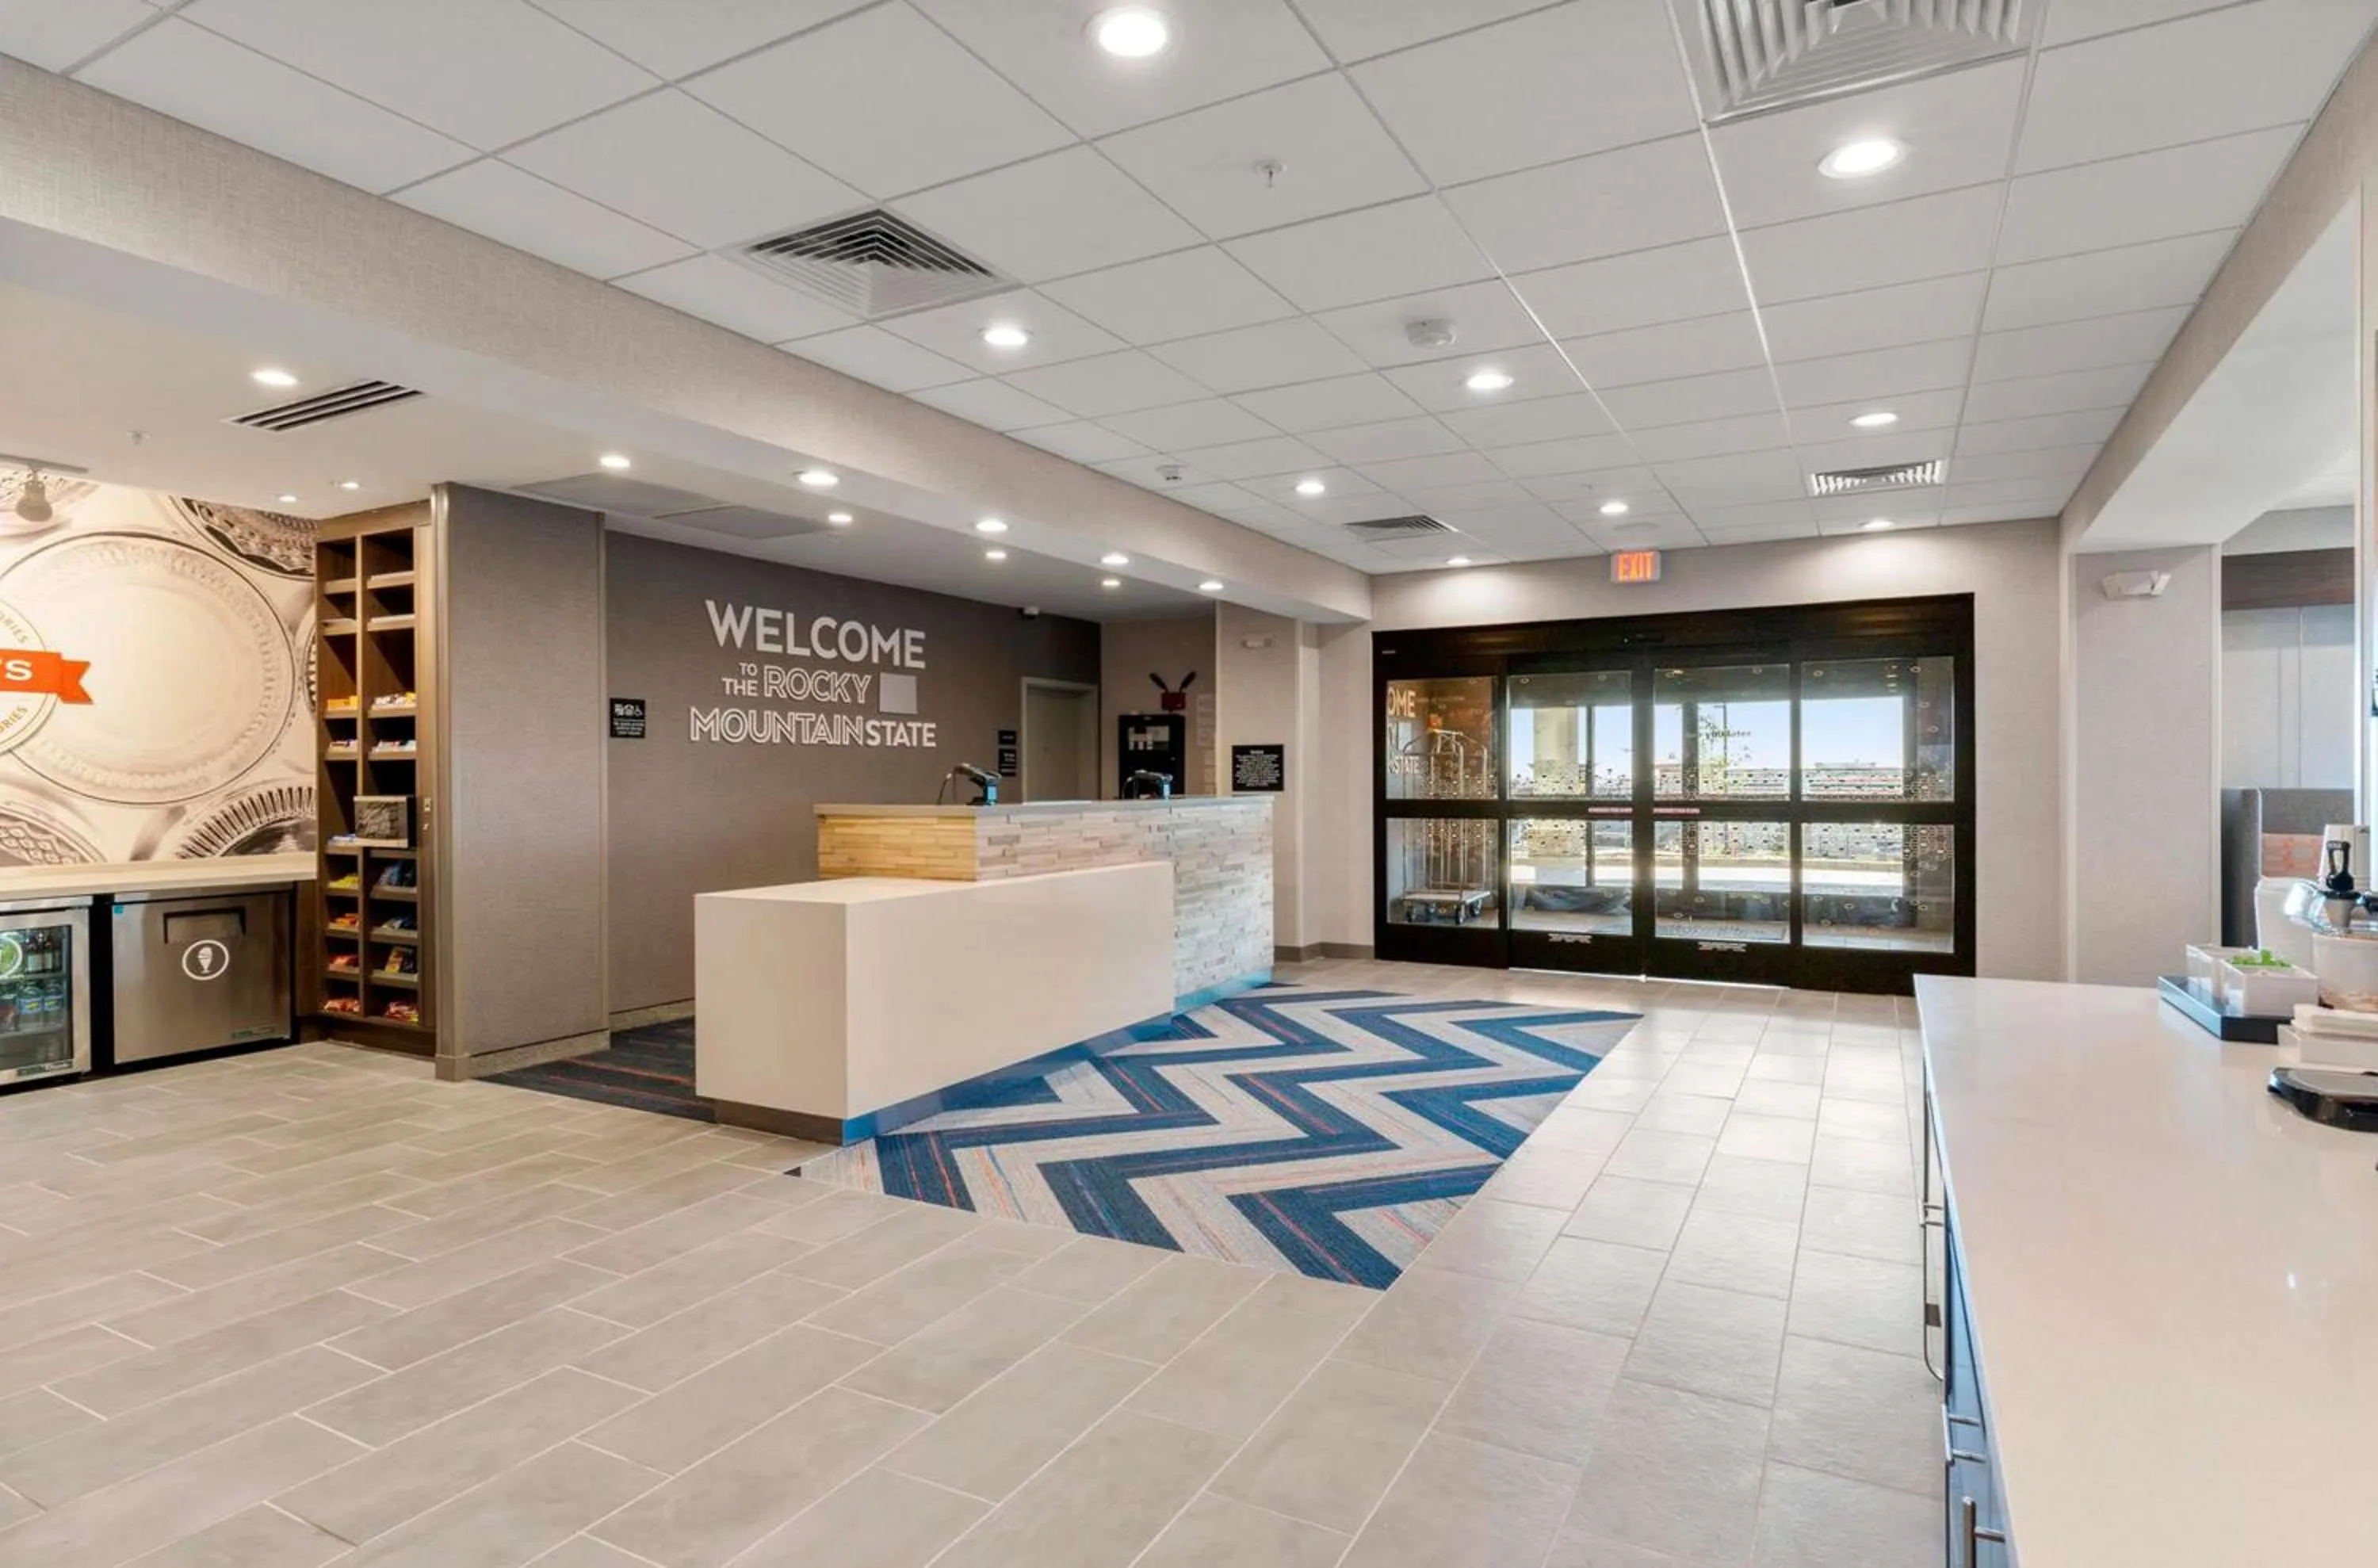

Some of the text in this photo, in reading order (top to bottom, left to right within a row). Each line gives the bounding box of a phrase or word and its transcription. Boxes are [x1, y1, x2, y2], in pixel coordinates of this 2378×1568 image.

[1618, 553, 1654, 580] EXIT
[705, 600, 926, 669] WELCOME
[0, 659, 32, 682] S
[739, 663, 758, 676] TO
[722, 665, 871, 704] THE ROCKY
